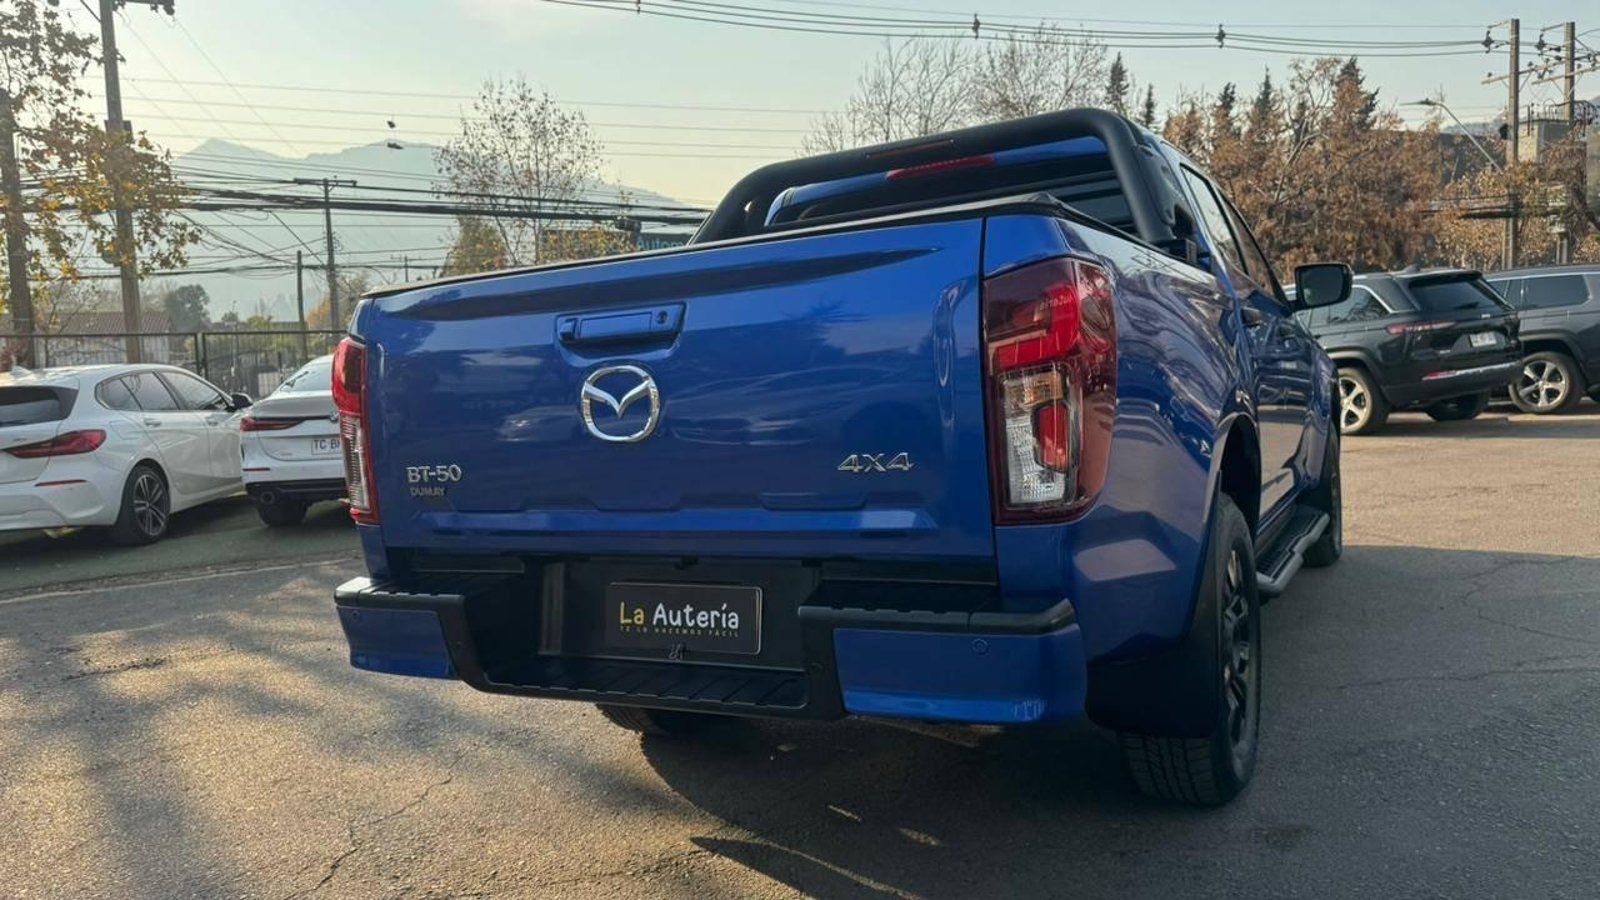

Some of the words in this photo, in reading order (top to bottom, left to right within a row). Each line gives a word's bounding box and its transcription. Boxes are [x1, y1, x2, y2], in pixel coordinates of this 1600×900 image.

[313, 439, 327, 450] TC
[406, 464, 462, 483] BT-50
[619, 601, 645, 625] La
[652, 602, 740, 630] Autería
